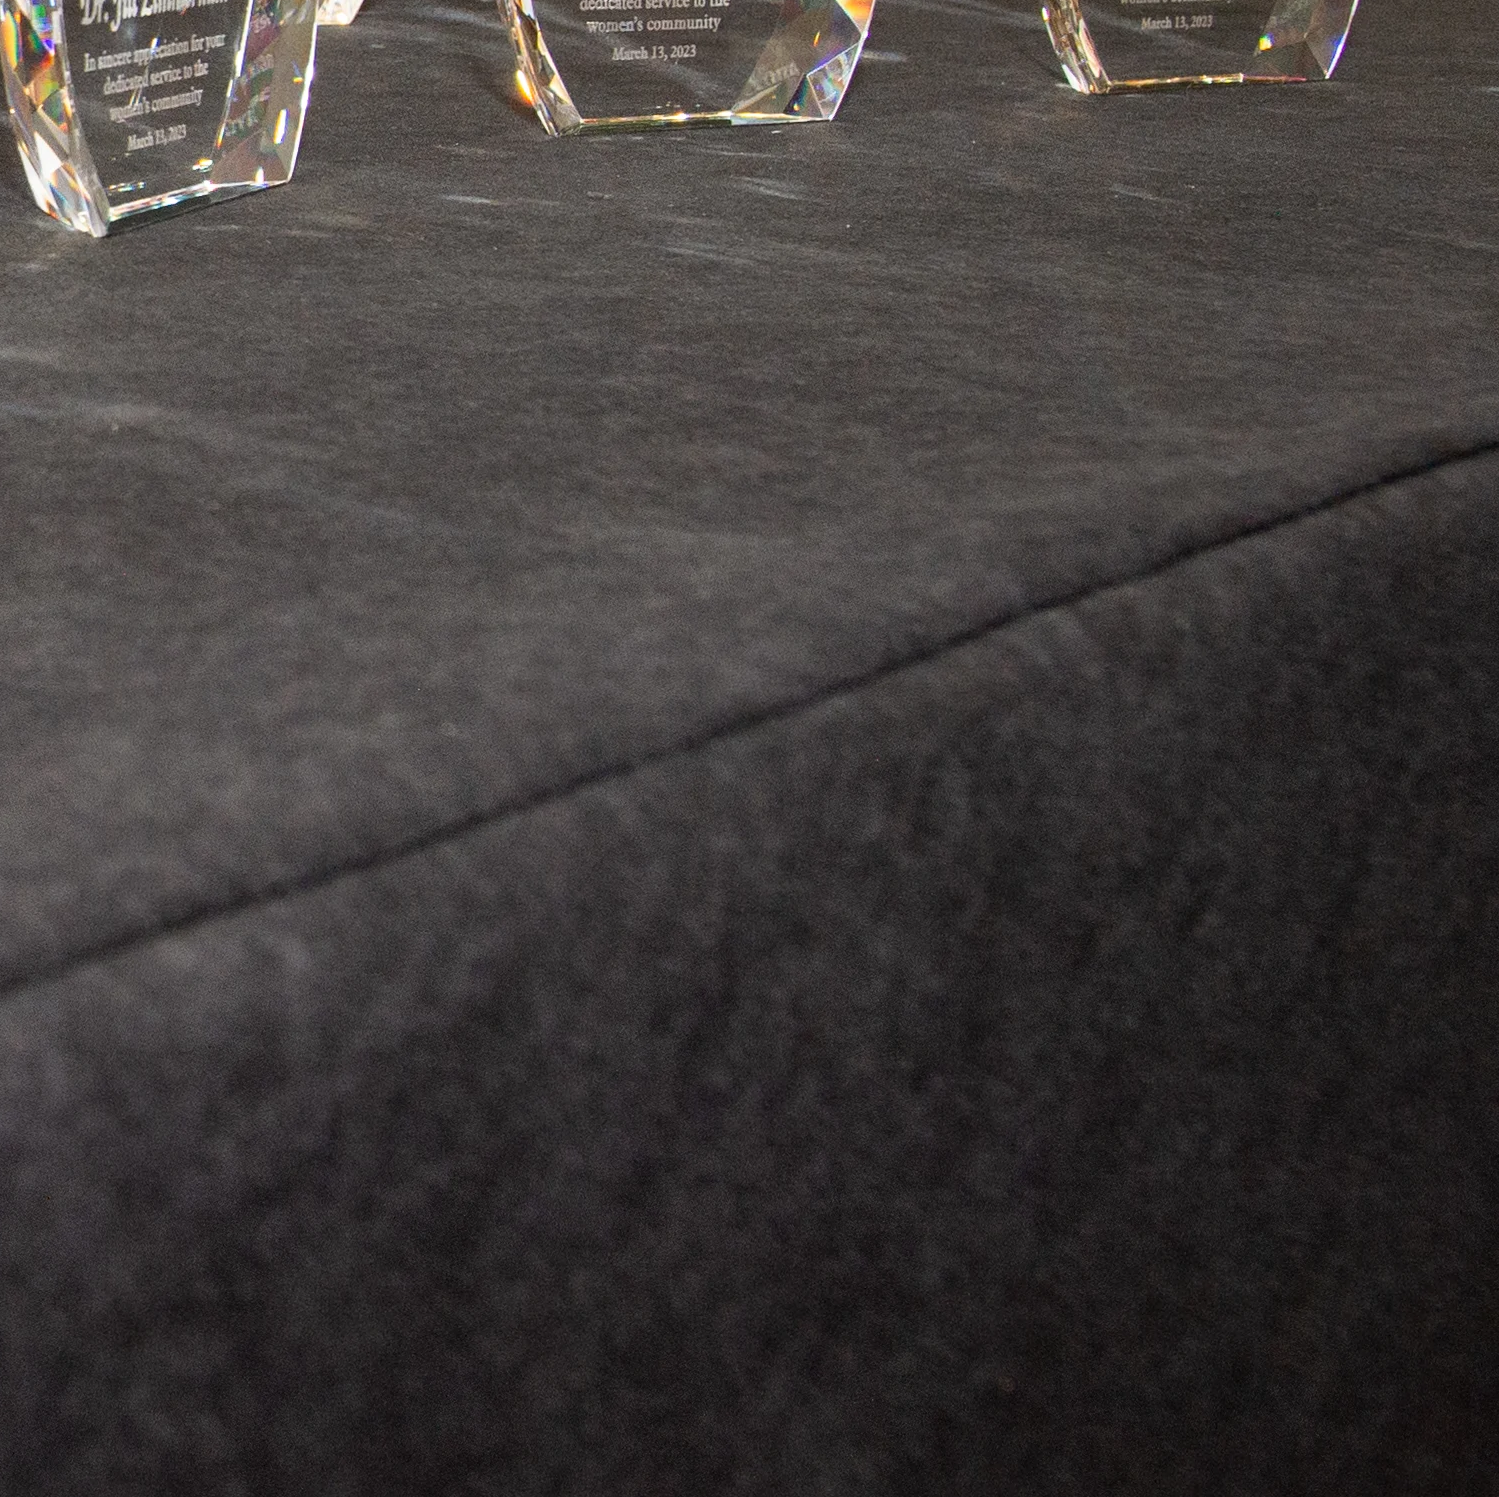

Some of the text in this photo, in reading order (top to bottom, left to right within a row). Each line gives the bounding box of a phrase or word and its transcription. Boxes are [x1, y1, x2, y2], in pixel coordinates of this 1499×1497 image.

[586, 14, 721, 33] women's community
[1141, 15, 1213, 30] March 13, 2023
[84, 53, 96, 72] In
[98, 50, 131, 69] sincere
[190, 34, 204, 51] for
[205, 34, 226, 53] your
[612, 44, 697, 61] March 13, 2023
[104, 58, 209, 95] dedicated service to the
[152, 86, 204, 112] community
[127, 124, 186, 151] March 13, 2023
